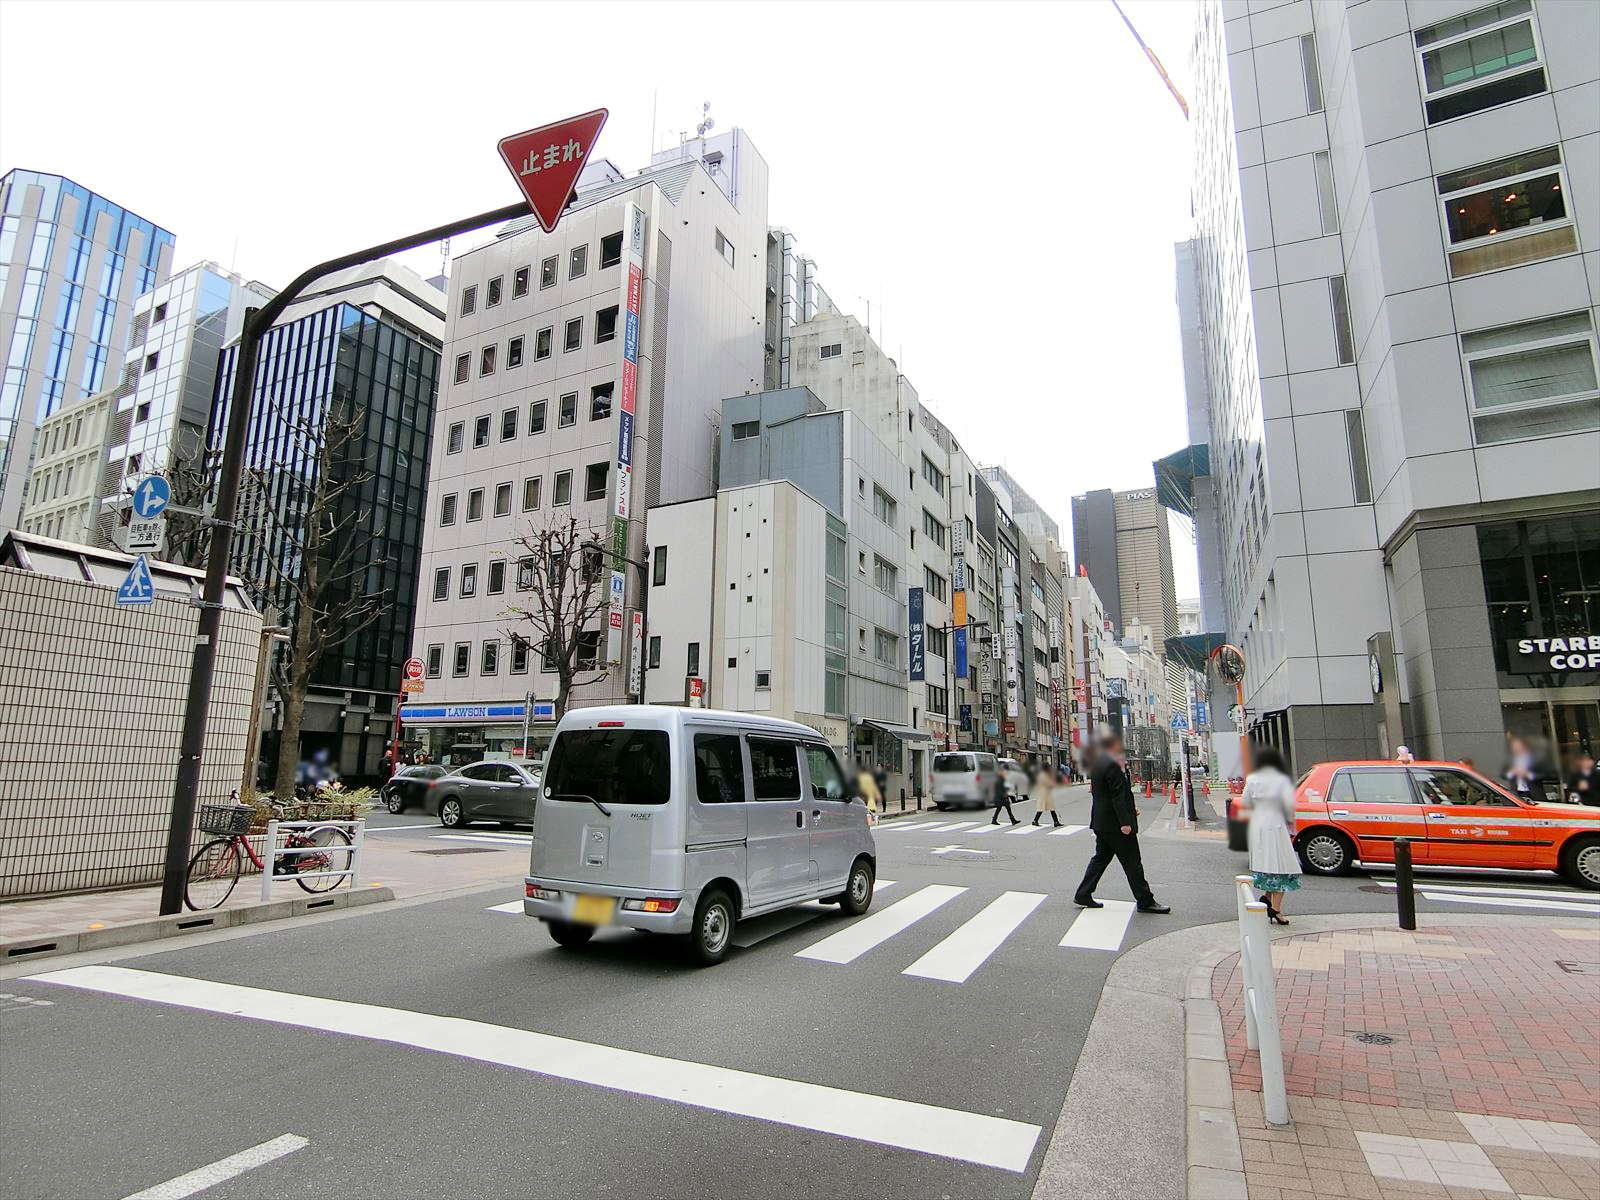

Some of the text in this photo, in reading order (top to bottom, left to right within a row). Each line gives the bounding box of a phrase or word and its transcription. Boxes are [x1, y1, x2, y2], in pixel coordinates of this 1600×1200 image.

[520, 138, 584, 177] 止まれ
[631, 278, 640, 313] FASTNAIL
[1127, 491, 1152, 500] PIAS
[131, 523, 161, 532] 自転車を除く
[130, 533, 160, 541] 一方通行
[447, 707, 487, 717] LAWSON
